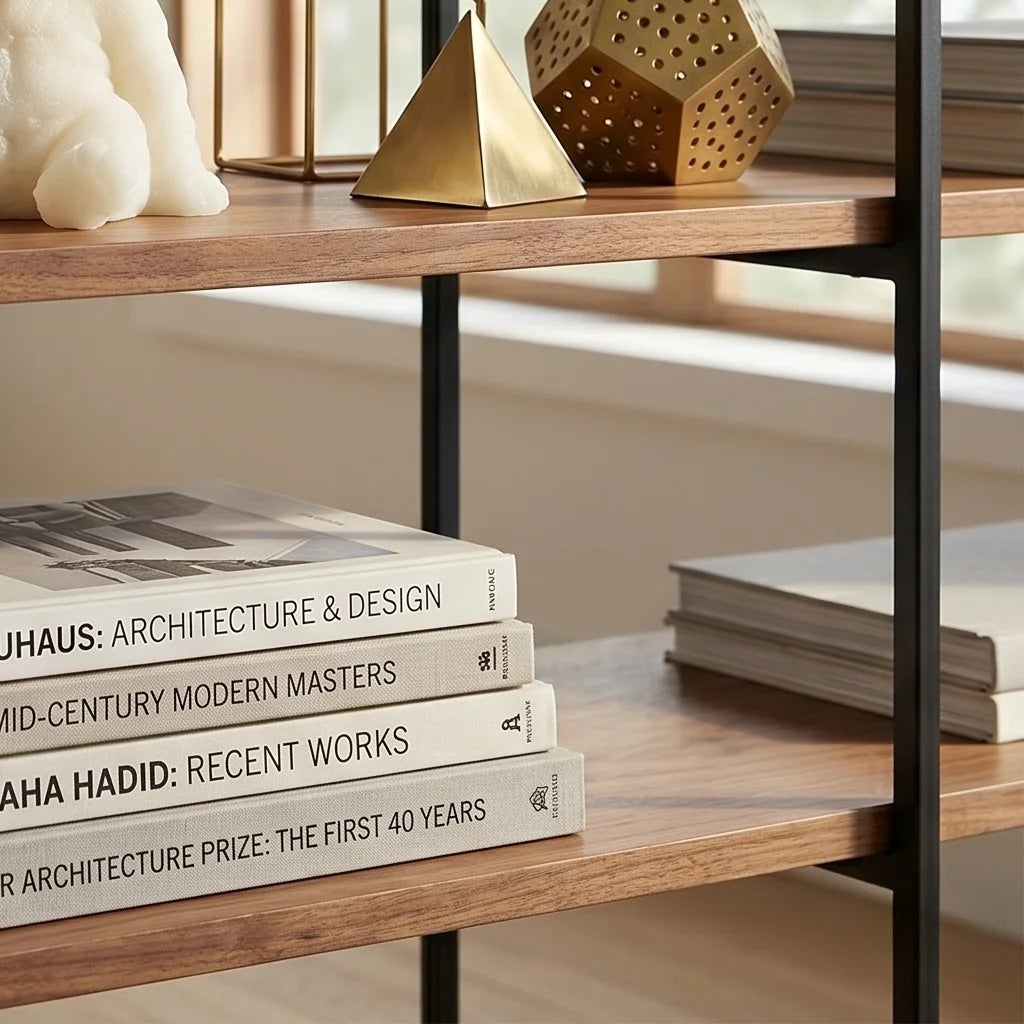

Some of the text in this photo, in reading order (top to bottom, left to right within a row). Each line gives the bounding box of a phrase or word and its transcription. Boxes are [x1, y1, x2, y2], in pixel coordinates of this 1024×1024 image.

[111, 597, 316, 647] ARCHITECTURE
[323, 594, 342, 622] &
[348, 582, 442, 619] DESIGN
[173, 675, 279, 712] MODERN
[287, 660, 397, 699] MASTERS
[74, 759, 179, 802] HADID:
[187, 741, 299, 786] RECENT
[307, 725, 410, 768] WORKS
[21, 846, 195, 893] ARCHITECTURE
[201, 831, 271, 868] PRIZE:
[276, 821, 319, 852] THE
[324, 814, 385, 846] FIRST
[388, 807, 415, 833] 40
[420, 797, 487, 829] YEARS
